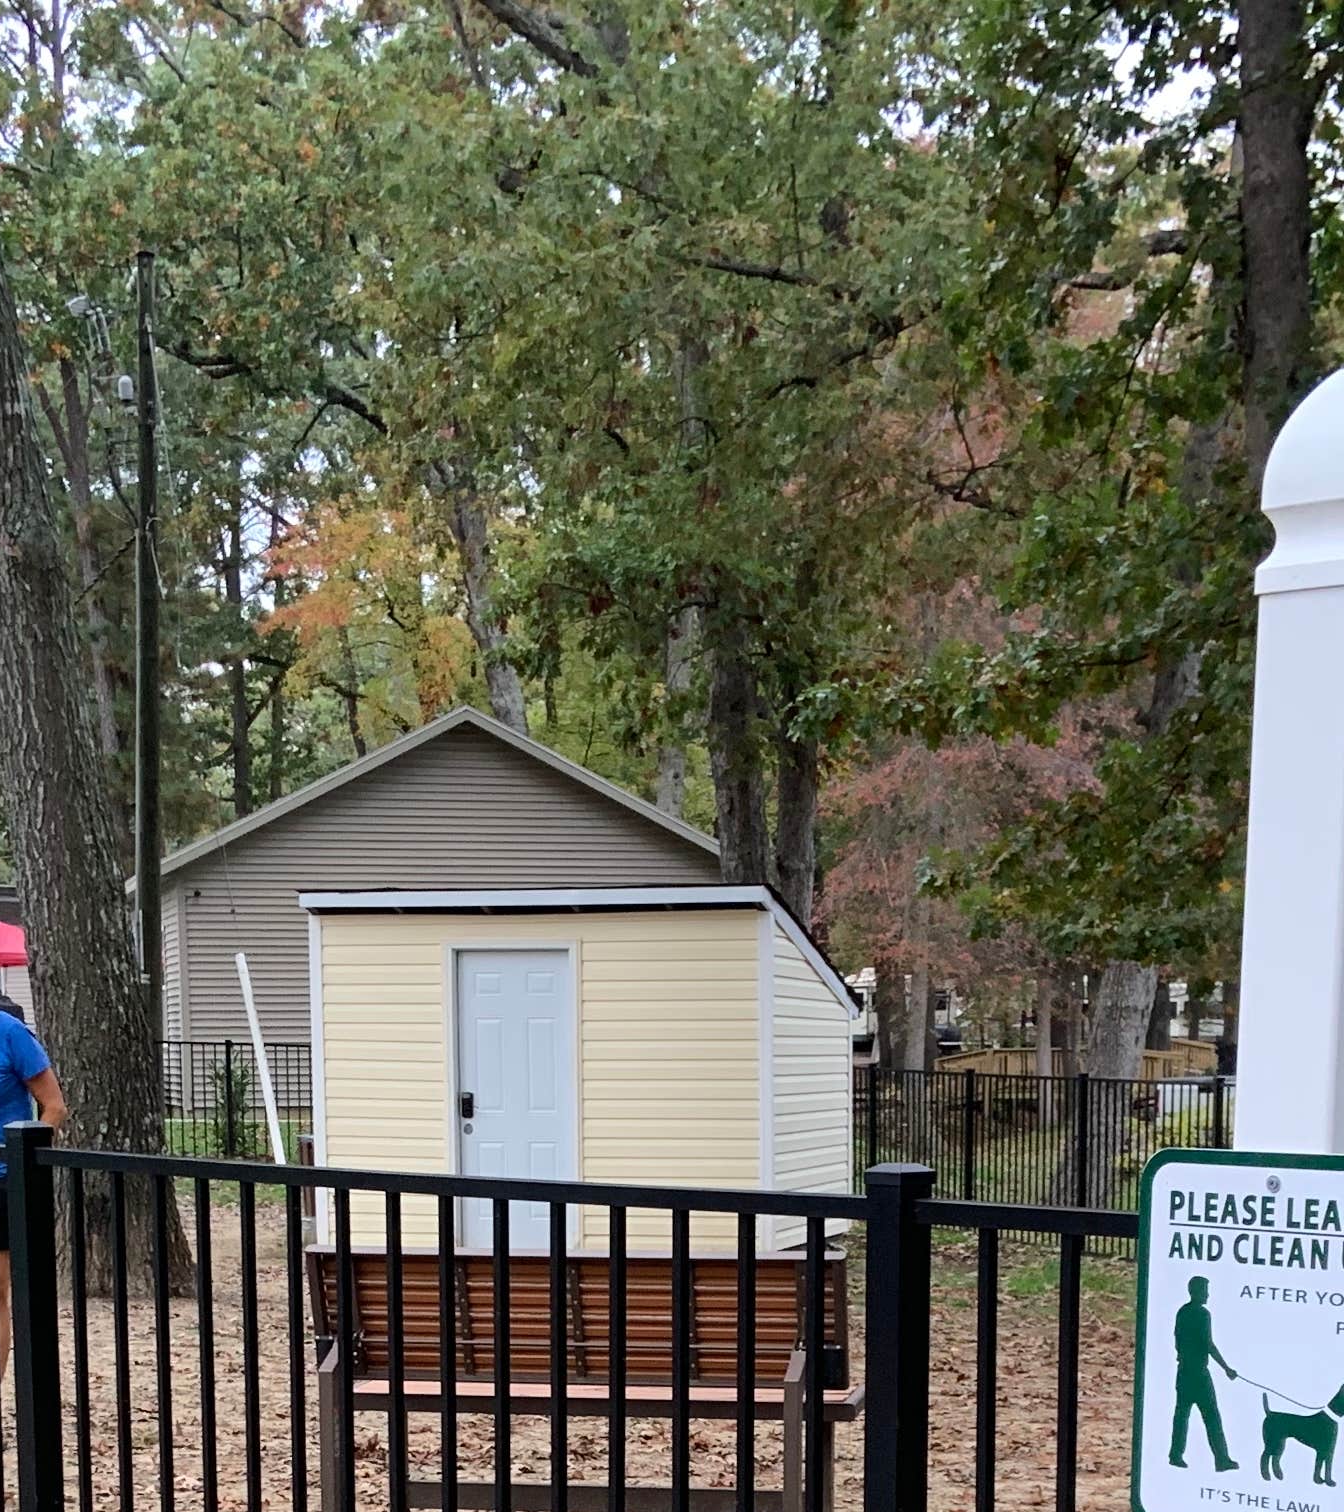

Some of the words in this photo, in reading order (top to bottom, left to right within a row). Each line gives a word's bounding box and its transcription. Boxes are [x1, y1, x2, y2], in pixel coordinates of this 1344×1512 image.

[1169, 1190, 1276, 1228] PLEASE
[1168, 1231, 1224, 1262] AND
[1233, 1233, 1329, 1271] CLEAN
[1239, 1284, 1308, 1304] AFTER
[1199, 1486, 1232, 1504] IT'S
[1235, 1492, 1270, 1510] THE
